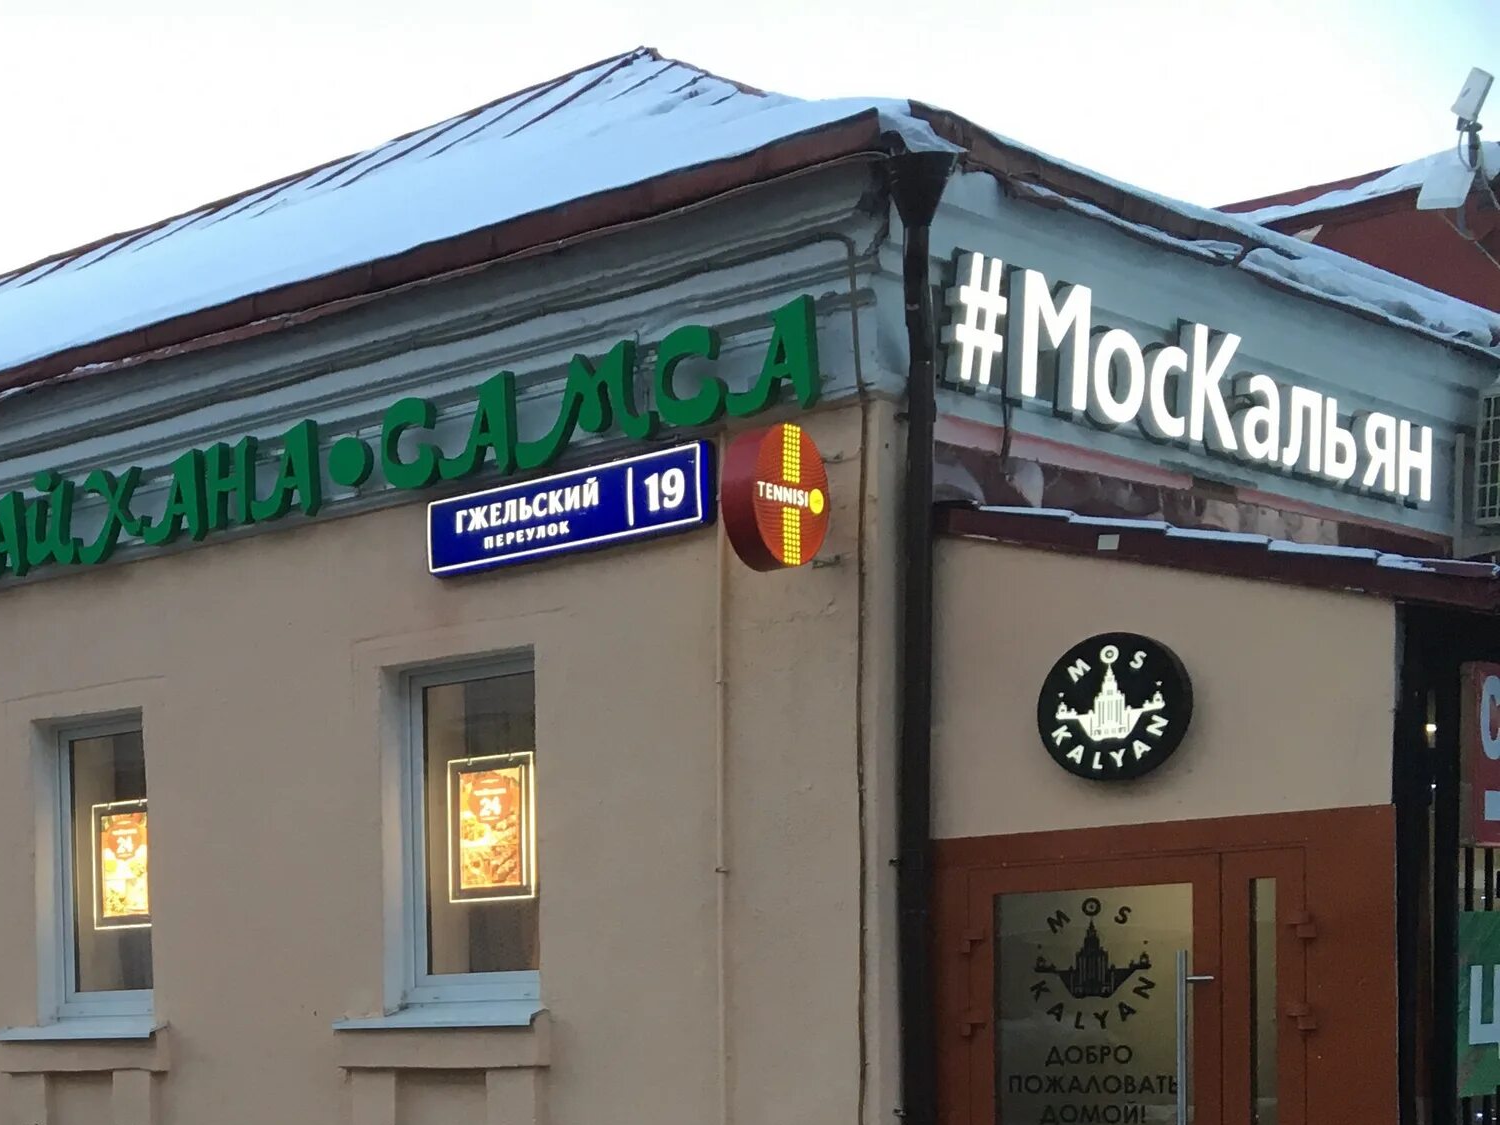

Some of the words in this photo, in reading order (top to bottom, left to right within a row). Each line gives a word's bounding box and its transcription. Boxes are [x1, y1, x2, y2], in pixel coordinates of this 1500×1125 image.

[381, 294, 820, 489] САМСА
[944, 250, 1434, 501] #МосКальян
[454, 477, 600, 535] ГЖЕЛЬСКИЙ
[643, 467, 686, 514] 19
[756, 480, 810, 509] TENNISI
[483, 519, 571, 551] ПЕРЕУЛОК
[1066, 644, 1148, 684] MOS
[1051, 714, 1169, 770] KALYAN
[1046, 897, 1132, 934] MOS
[1029, 976, 1156, 1030] KALYAN
[1044, 1044, 1133, 1067] ДОБРО
[1008, 1075, 1178, 1095] ПОЖАЛОВАТЬ
